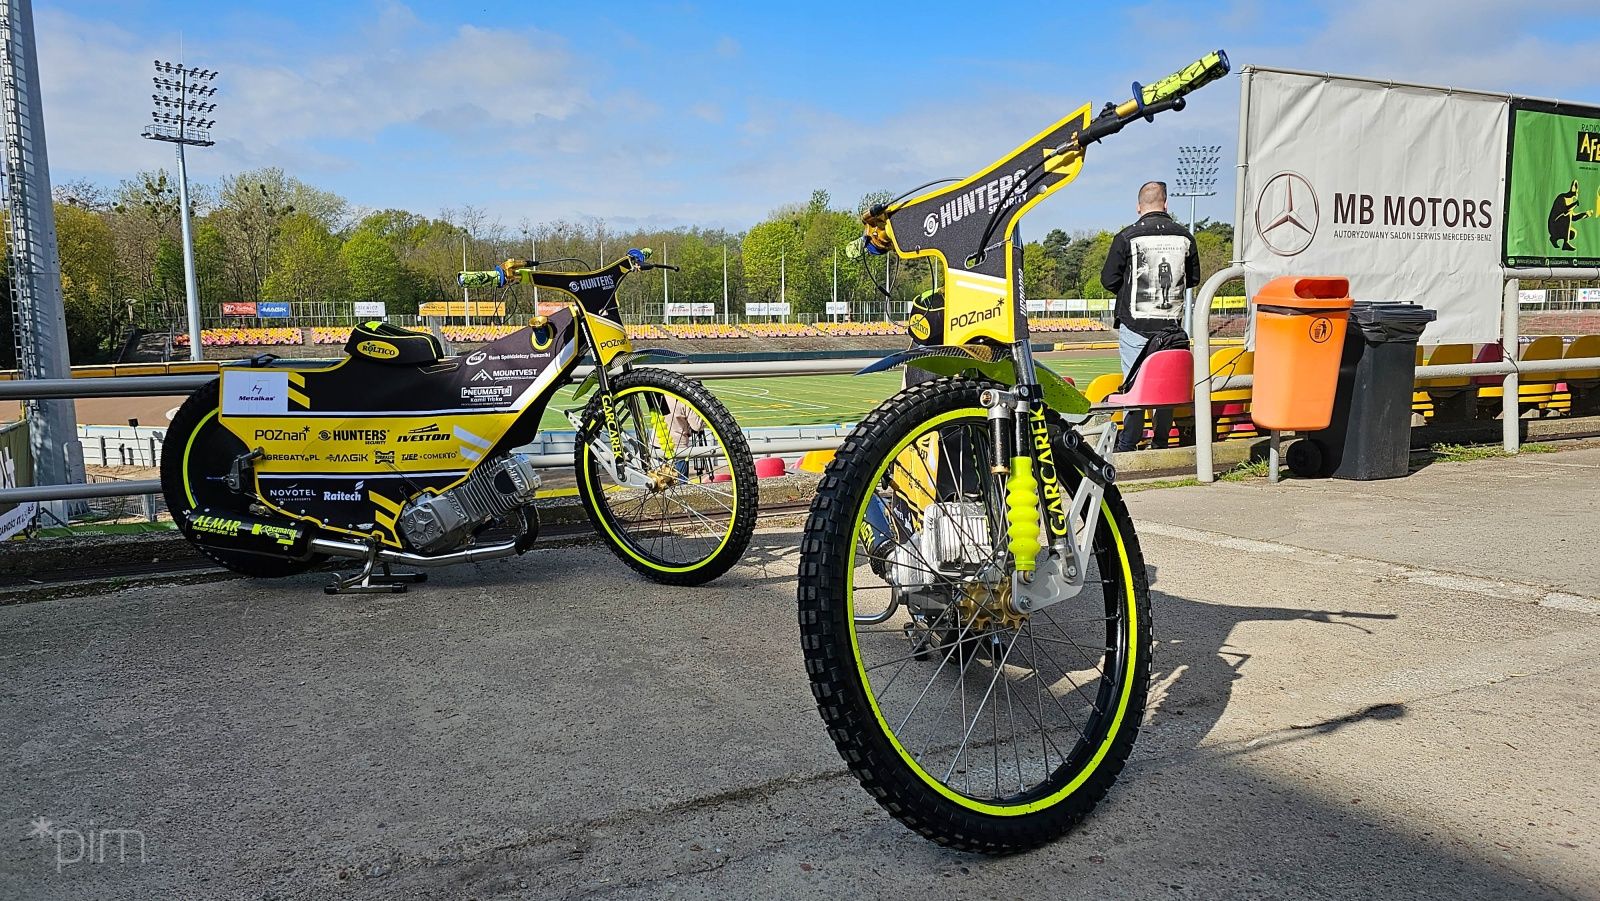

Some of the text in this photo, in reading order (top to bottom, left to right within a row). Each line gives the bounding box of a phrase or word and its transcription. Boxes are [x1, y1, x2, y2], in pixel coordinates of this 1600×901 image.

[1334, 193, 1492, 228] MB MOTORS
[1333, 230, 1388, 239] AUTORYZOWANY
[1390, 232, 1411, 240] SALON
[580, 274, 614, 290] HUNTERS
[362, 344, 395, 356] ROLTICO
[493, 368, 537, 377] MOUNTVEST
[463, 387, 510, 396] PNEUMASTER
[602, 394, 623, 460] GARCAREK
[333, 430, 387, 441] HUNTERS
[397, 433, 451, 442] IVESTON
[423, 452, 457, 460] COMERTO
[1029, 403, 1067, 536] GARCAREK
[270, 489, 316, 497] NOVOTEL
[323, 490, 362, 501] Raitech
[193, 515, 241, 532] ALMAR
